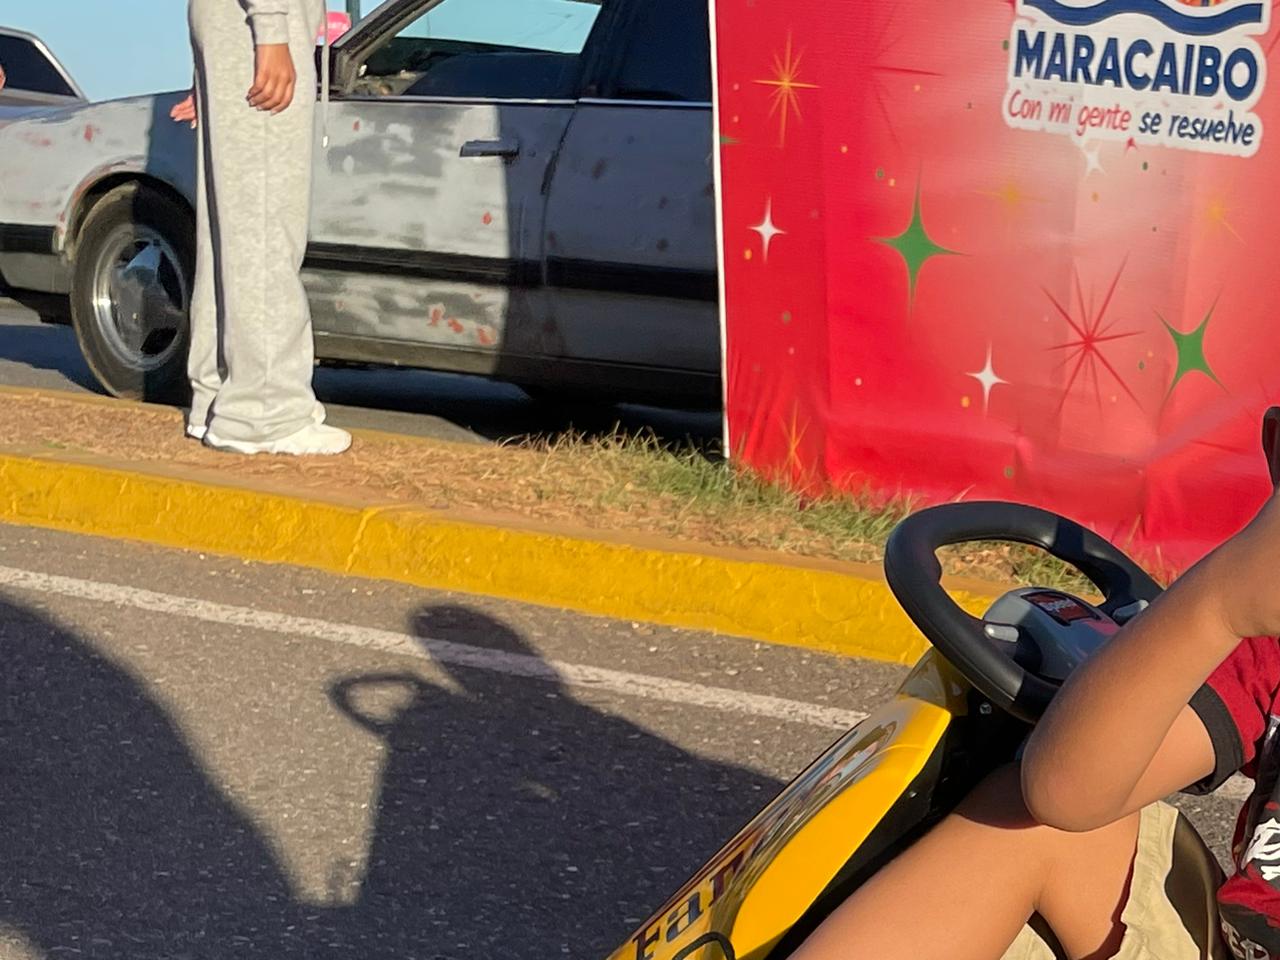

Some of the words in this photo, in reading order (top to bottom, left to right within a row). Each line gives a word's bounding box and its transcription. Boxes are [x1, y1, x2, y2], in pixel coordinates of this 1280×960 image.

[1013, 29, 1258, 101] MARACAIBO
[1008, 89, 1042, 120] Con
[1049, 96, 1073, 124] mi
[1077, 102, 1132, 136] gente
[1138, 110, 1163, 135] se
[1168, 110, 1255, 145] resuelve
